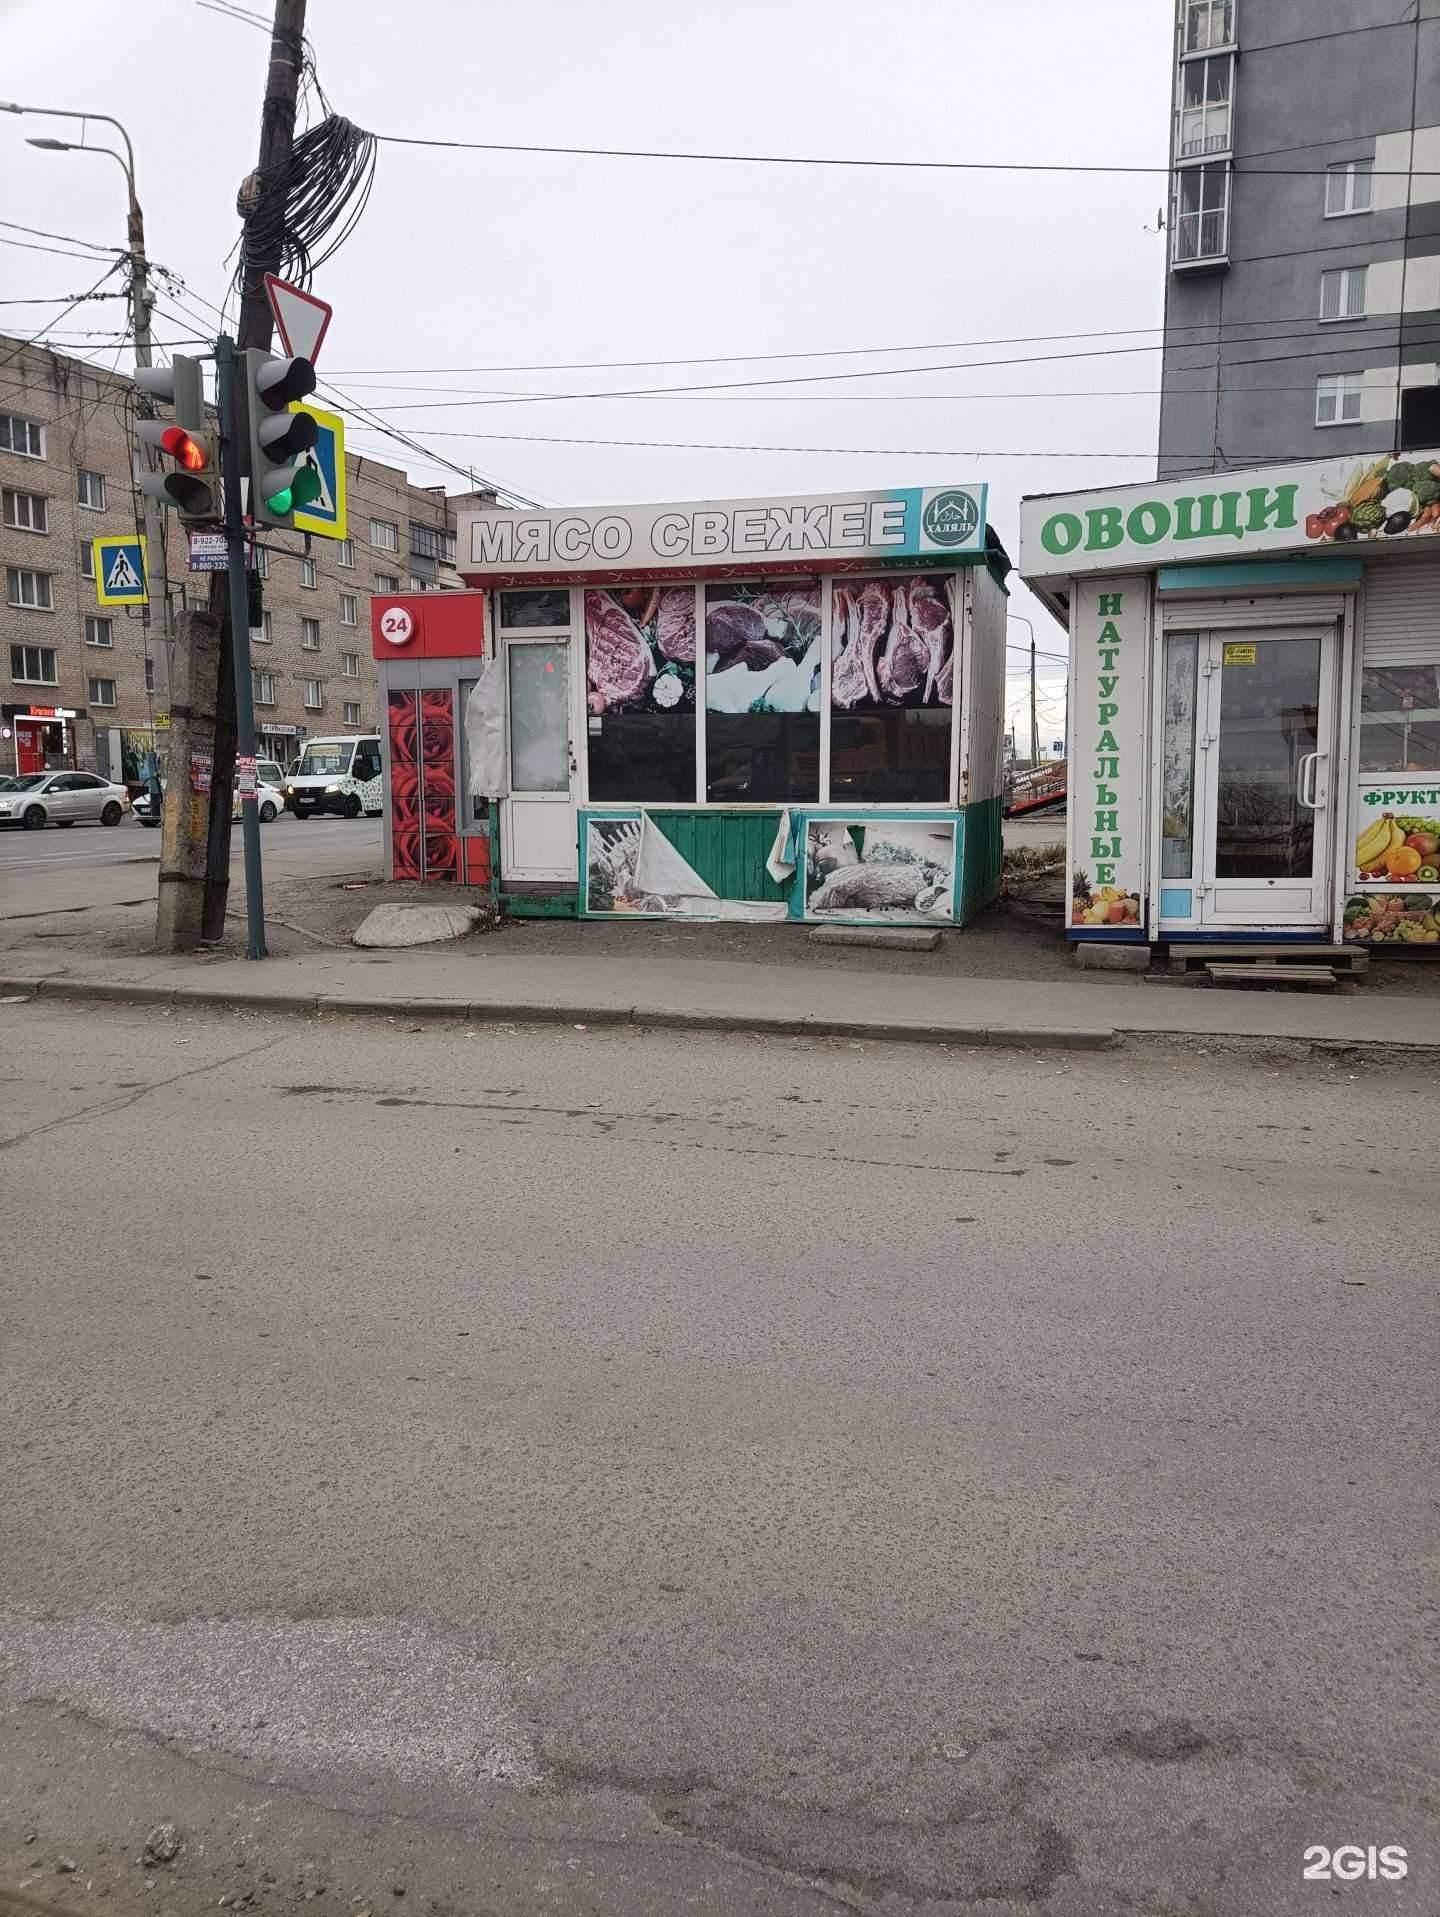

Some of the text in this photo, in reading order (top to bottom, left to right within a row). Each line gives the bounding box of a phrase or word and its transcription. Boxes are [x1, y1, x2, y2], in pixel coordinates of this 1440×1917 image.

[471, 501, 907, 563] МЯСО СВЕЖЕЕ
[927, 522, 975, 533] ХАЛЯЛЬ
[1040, 484, 1299, 555] ОВОЩИ
[193, 536, 229, 545] 8-922-70
[385, 618, 408, 633] 24
[1090, 592, 1122, 886] НАТУРАЛЬНЫЕ
